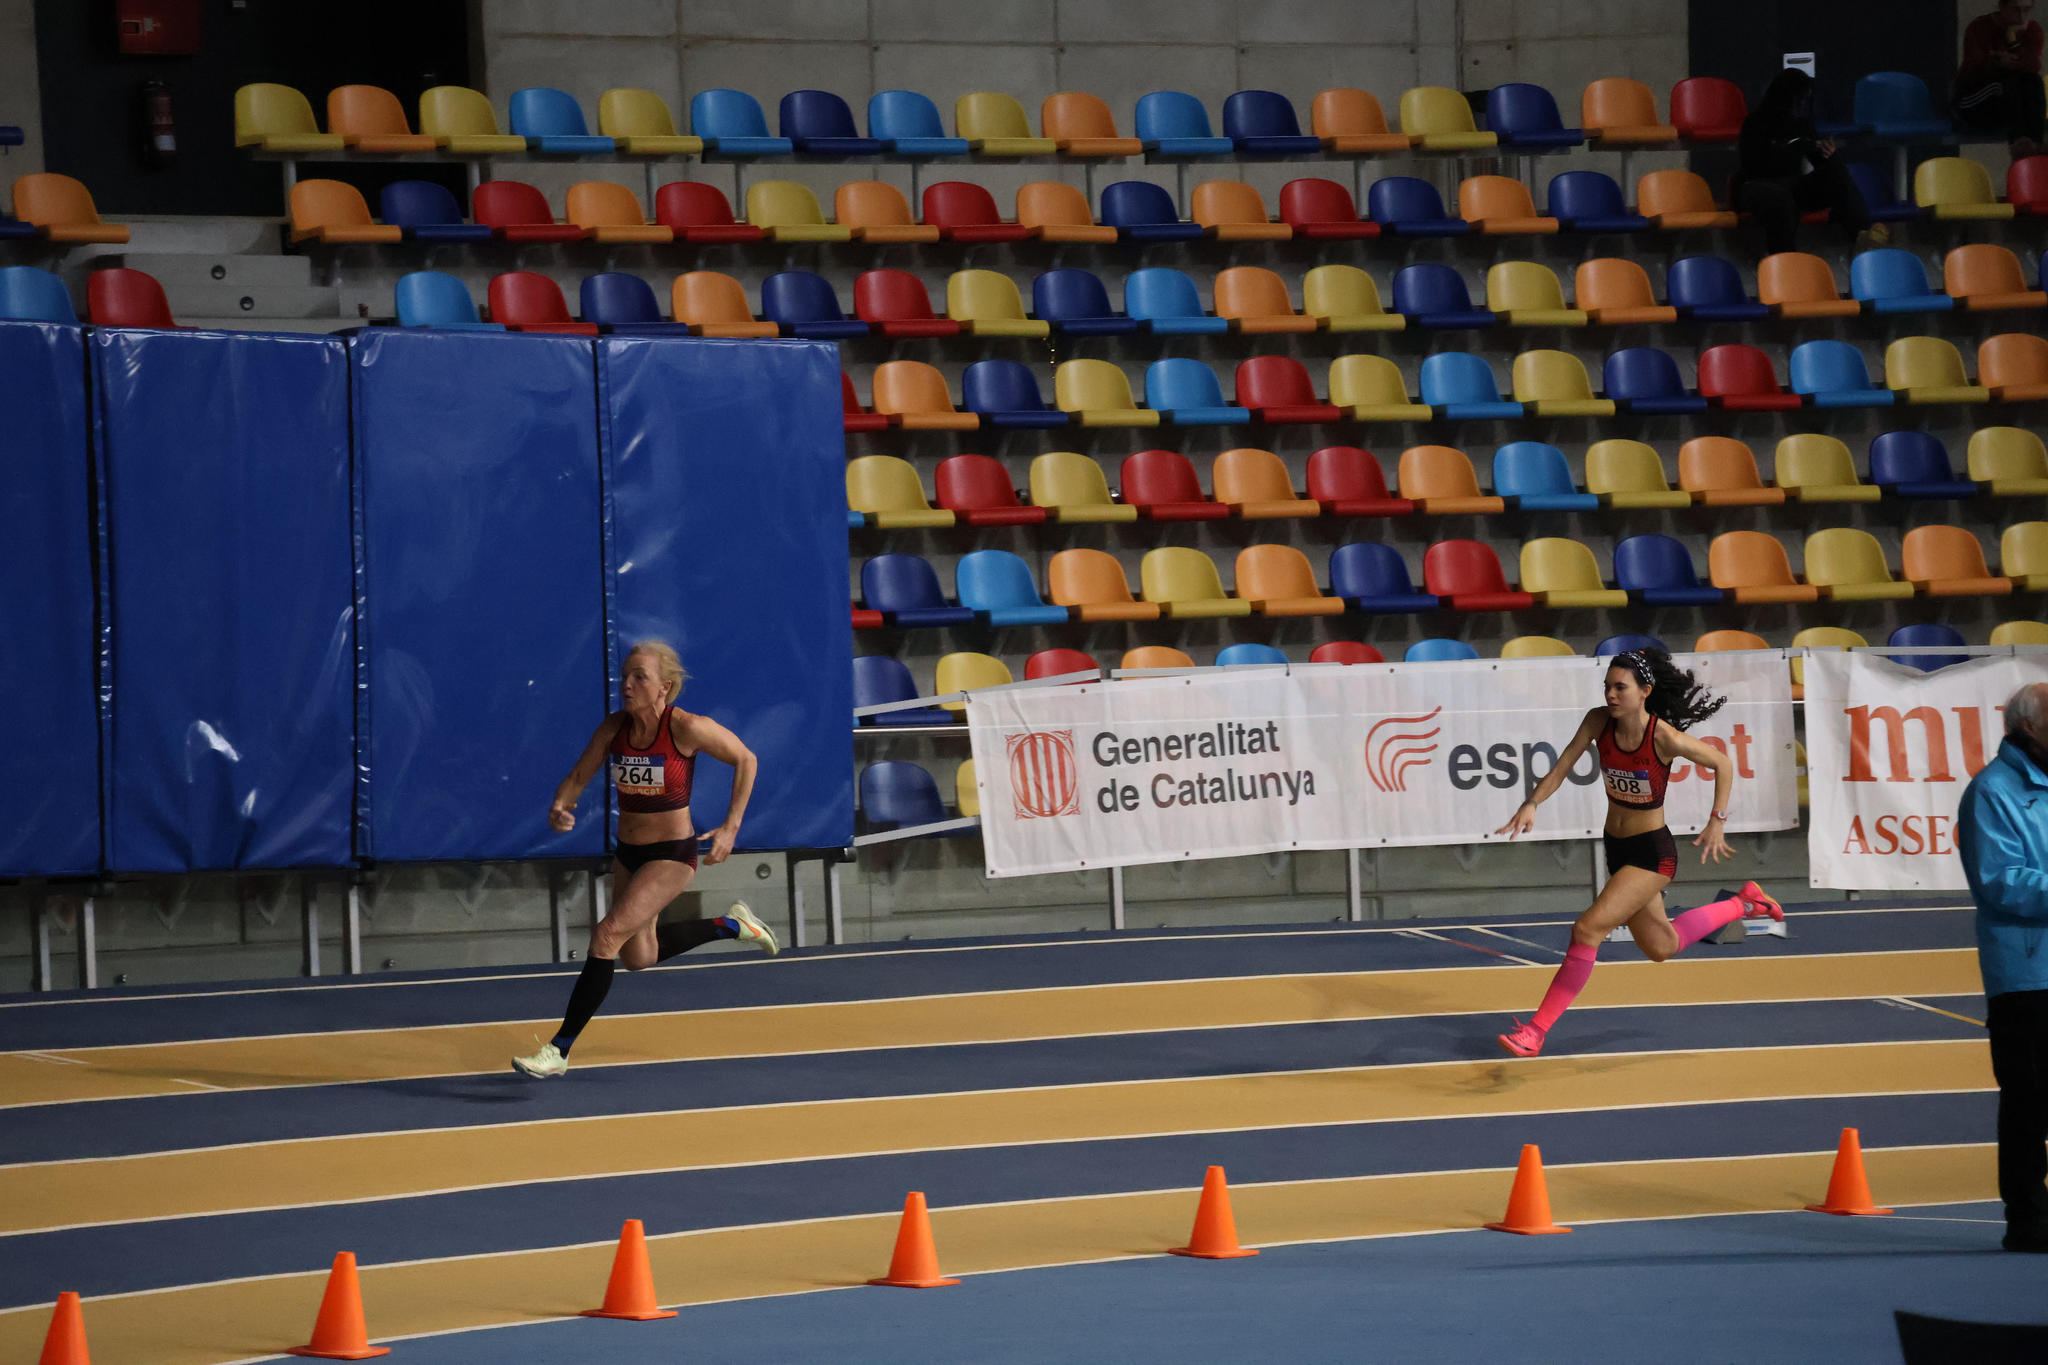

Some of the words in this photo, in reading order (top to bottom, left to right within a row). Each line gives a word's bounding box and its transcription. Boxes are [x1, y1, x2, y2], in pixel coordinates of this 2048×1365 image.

[1092, 720, 1280, 767] Generalitat
[618, 766, 653, 785] 264
[1097, 778, 1140, 813] de
[1151, 767, 1315, 809] Catalunya
[1607, 775, 1641, 794] 308
[1842, 815, 1960, 855] ASSE
